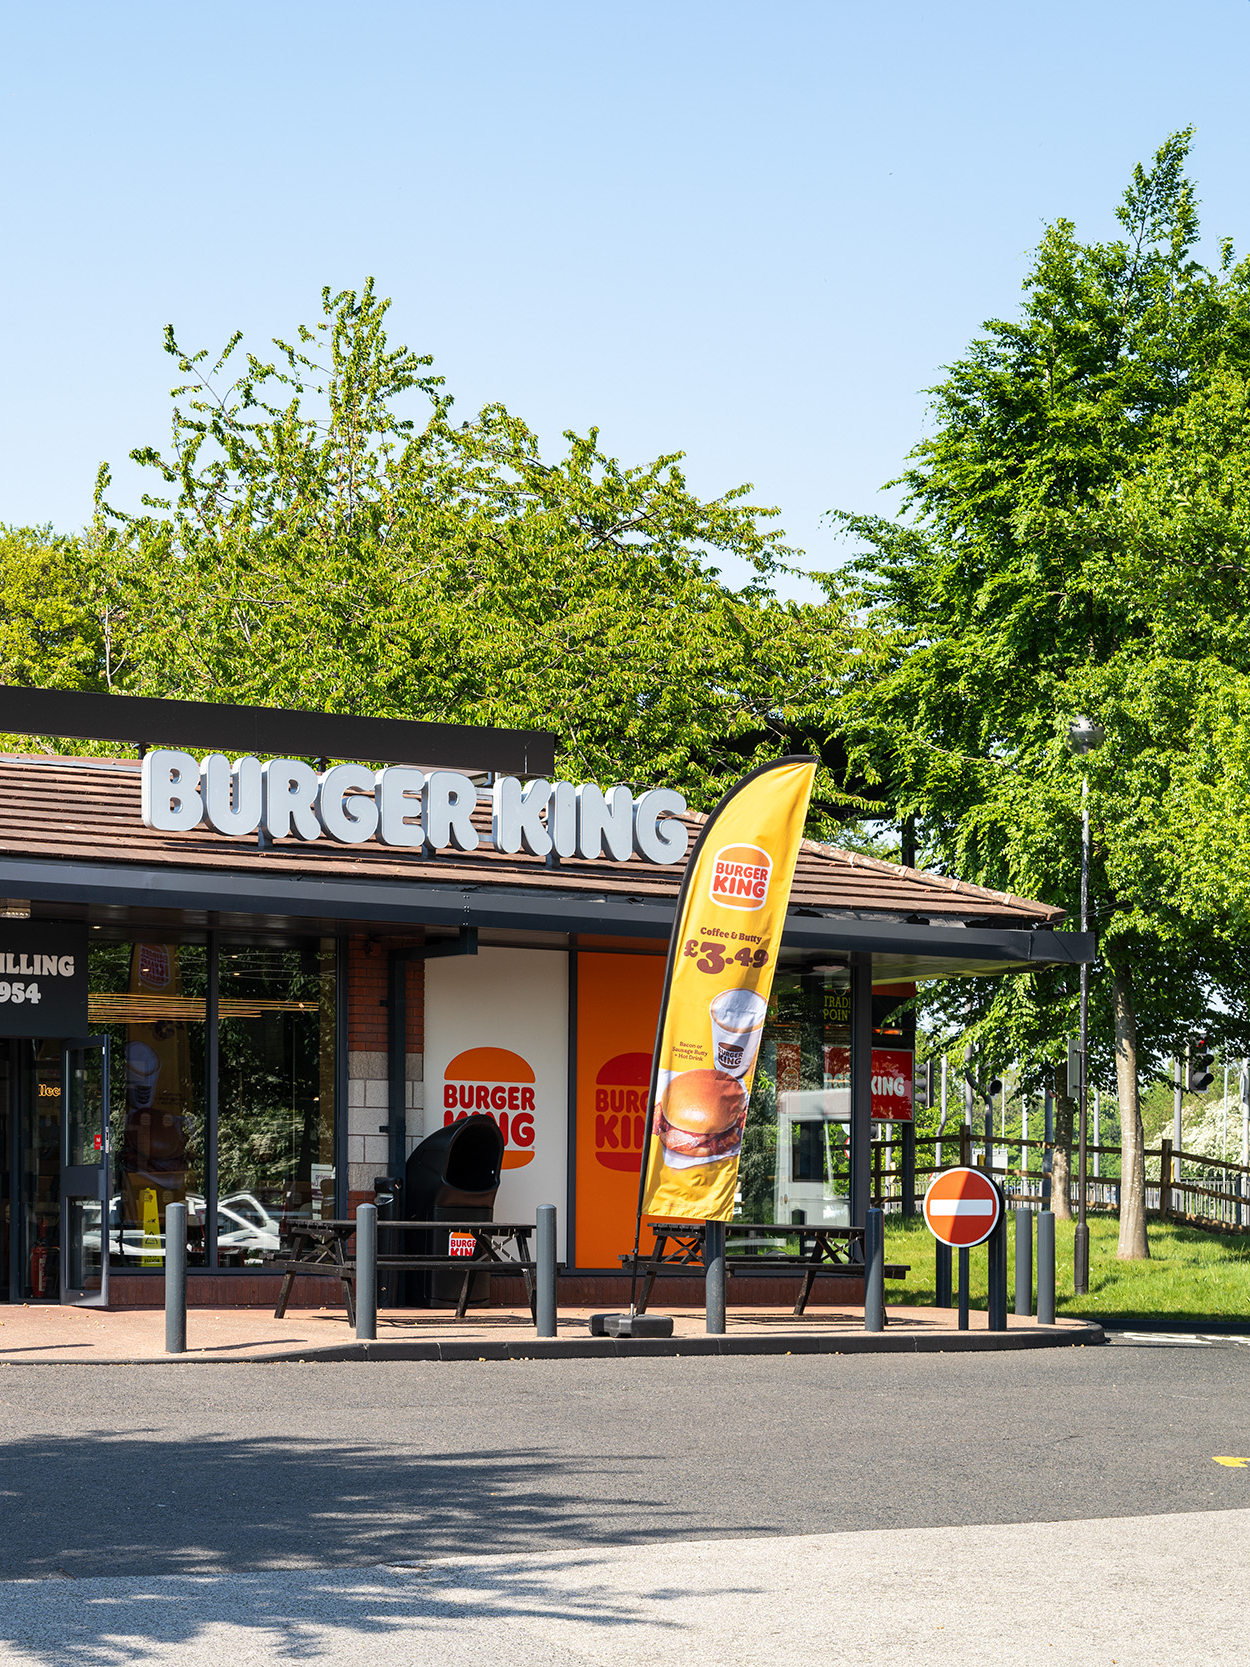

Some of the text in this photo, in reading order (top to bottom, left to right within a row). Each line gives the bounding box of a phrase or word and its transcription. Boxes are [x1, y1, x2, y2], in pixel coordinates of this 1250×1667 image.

[141, 749, 689, 865] BURGER KING
[715, 862, 768, 881] BURGER
[712, 875, 766, 898] KING
[700, 926, 763, 945] Coffee & Butty
[683, 939, 769, 975] £3.49
[824, 995, 850, 1009] TRAD
[824, 1008, 850, 1021] POIN
[672, 1046, 693, 1055] Sausage
[718, 1047, 744, 1058] BURGER
[718, 1053, 742, 1065] KING
[444, 1084, 536, 1111] BURGER
